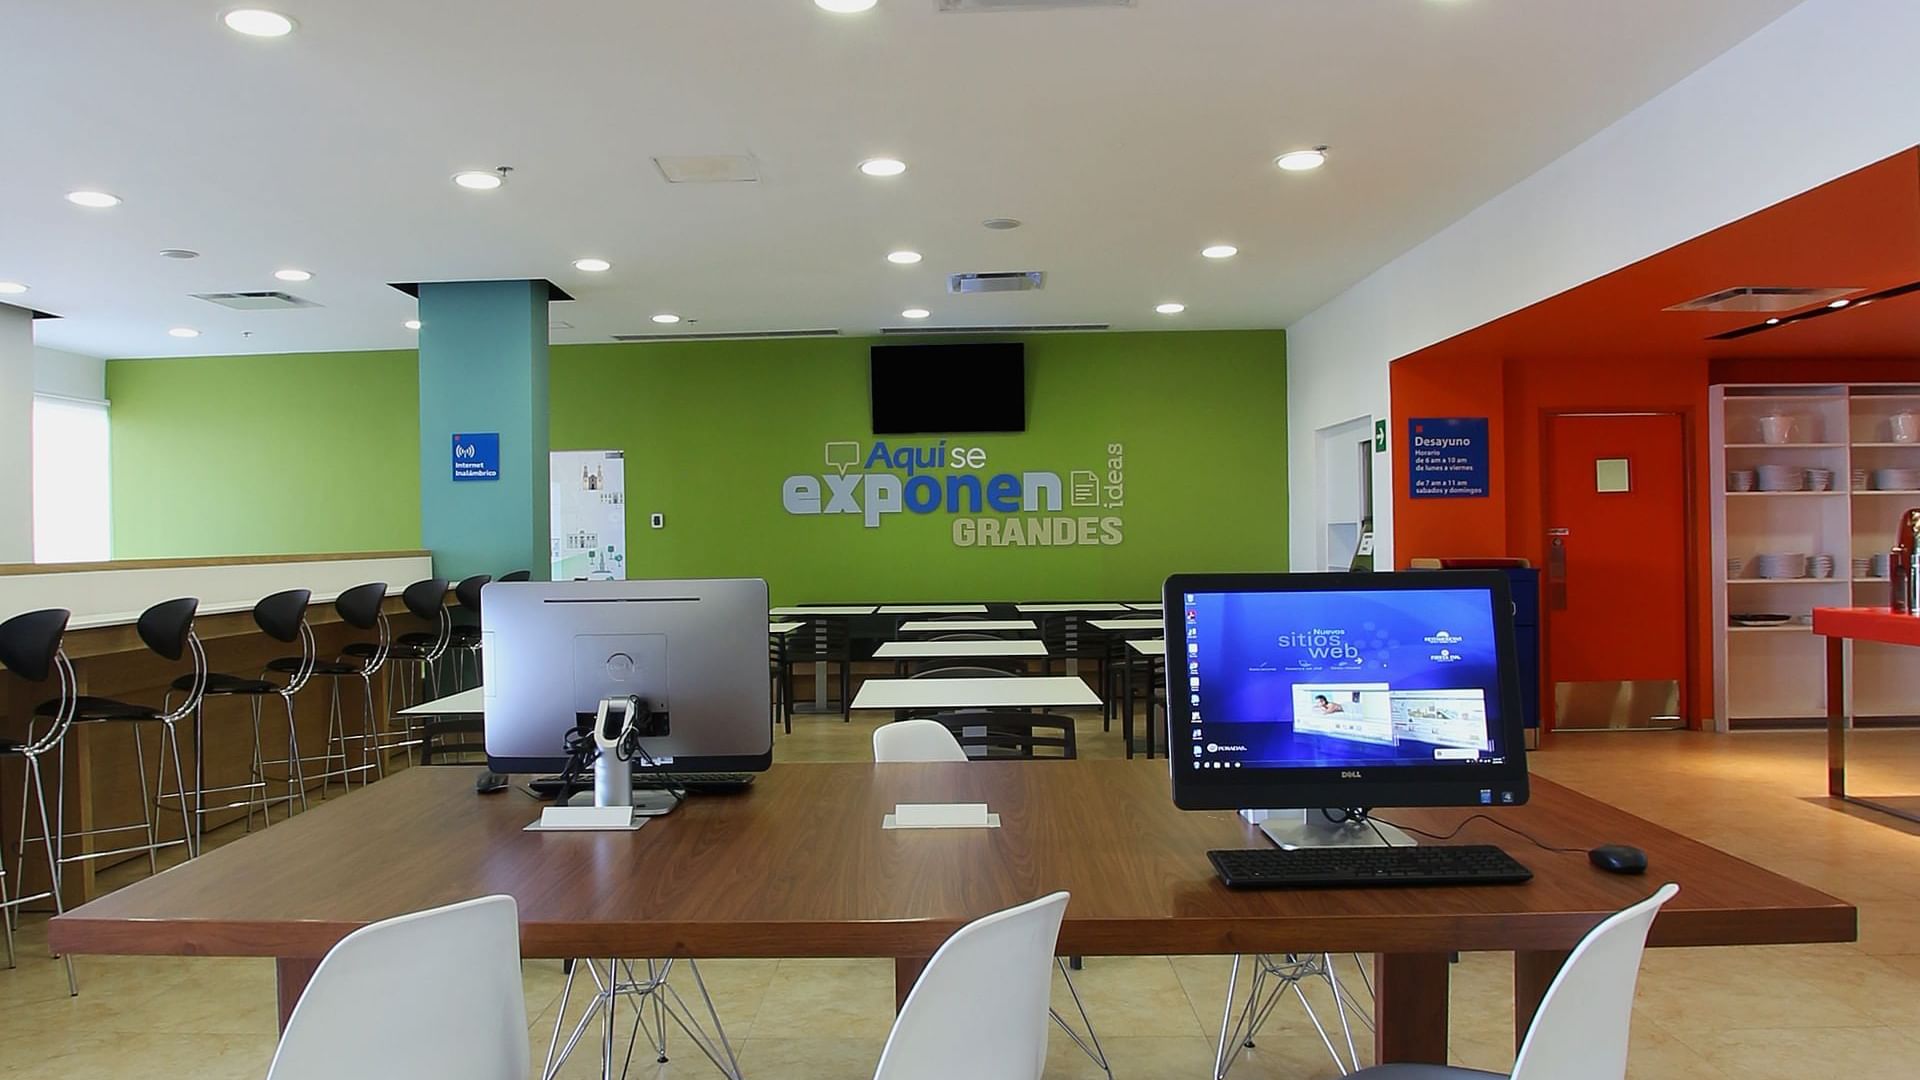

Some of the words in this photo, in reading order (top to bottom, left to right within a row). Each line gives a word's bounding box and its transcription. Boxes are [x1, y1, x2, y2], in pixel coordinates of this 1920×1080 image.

[1415, 436, 1471, 448] Desayuno
[864, 440, 946, 476] Aquí
[950, 447, 987, 469] se
[1103, 443, 1124, 509] ideas
[782, 471, 1062, 528] exponen
[1449, 487, 1482, 495] domingos
[952, 516, 1123, 547] GRANDES
[1278, 631, 1341, 648] sitios
[1313, 628, 1345, 636] Nuevos
[1308, 642, 1359, 659] web
